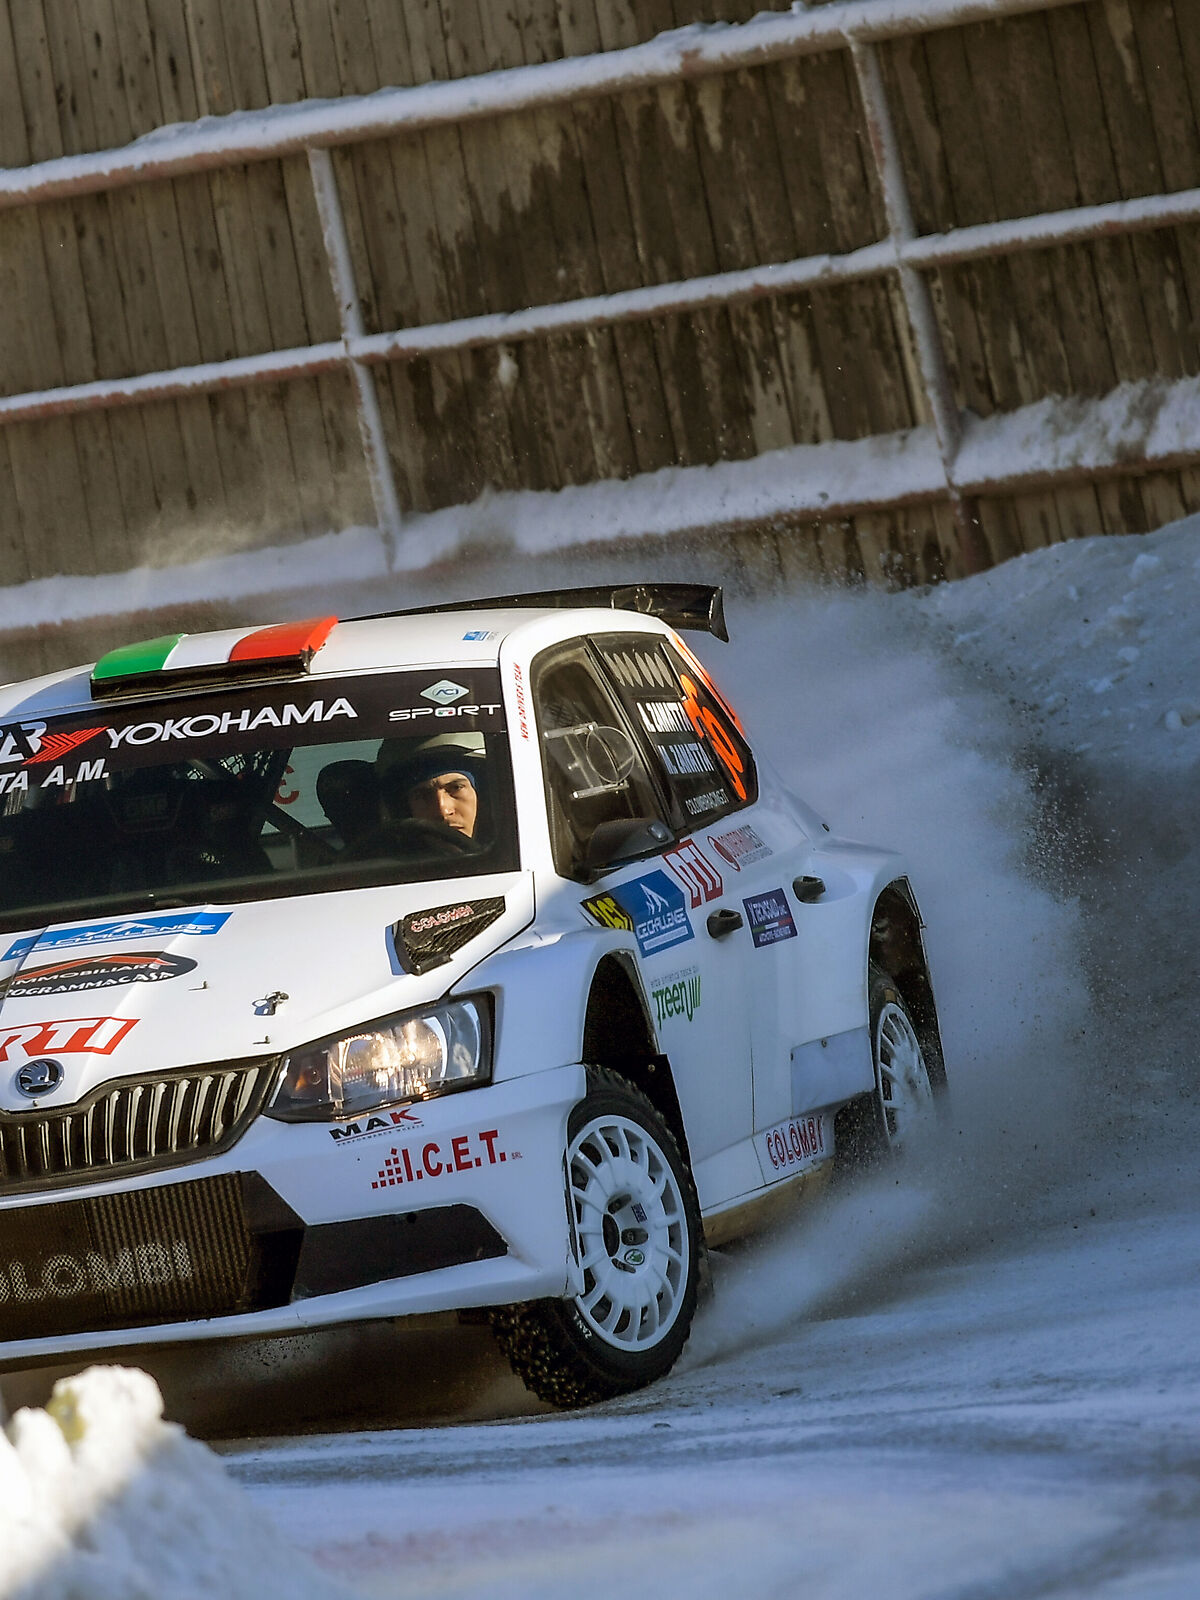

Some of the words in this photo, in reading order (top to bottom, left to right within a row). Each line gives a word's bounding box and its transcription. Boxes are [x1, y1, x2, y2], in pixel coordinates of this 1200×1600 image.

[106, 697, 359, 749] YOKOHAMA
[388, 704, 502, 722] SPORT
[40, 758, 111, 789] A.M.
[410, 904, 475, 933] COLOMBI
[10, 962, 163, 986] IMMOBILIARE
[328, 1108, 421, 1140] MAK
[401, 1129, 507, 1182] I.C.E.T.
[766, 1115, 824, 1170] COLOMBI
